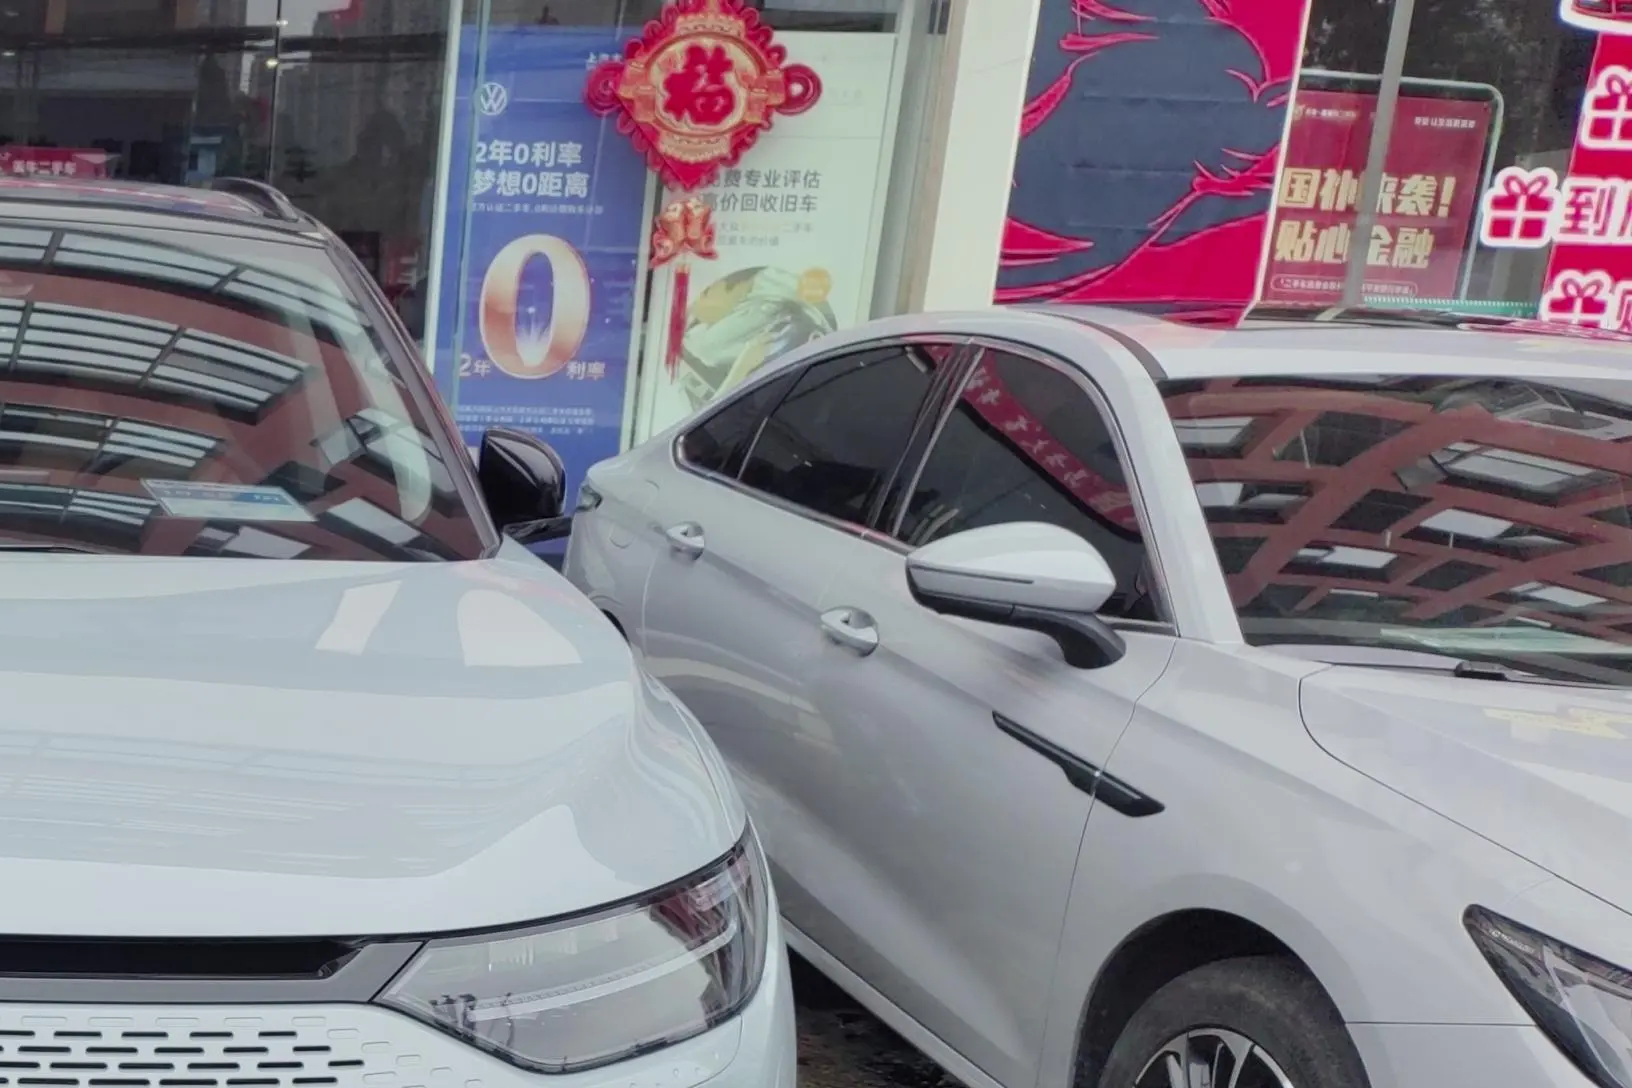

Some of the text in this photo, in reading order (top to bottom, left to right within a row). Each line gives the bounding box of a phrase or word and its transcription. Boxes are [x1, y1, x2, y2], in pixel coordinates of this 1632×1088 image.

[475, 140, 582, 167] 2年0利率
[471, 169, 590, 198] 梦想0距离
[1274, 220, 1435, 269] 贴心金融
